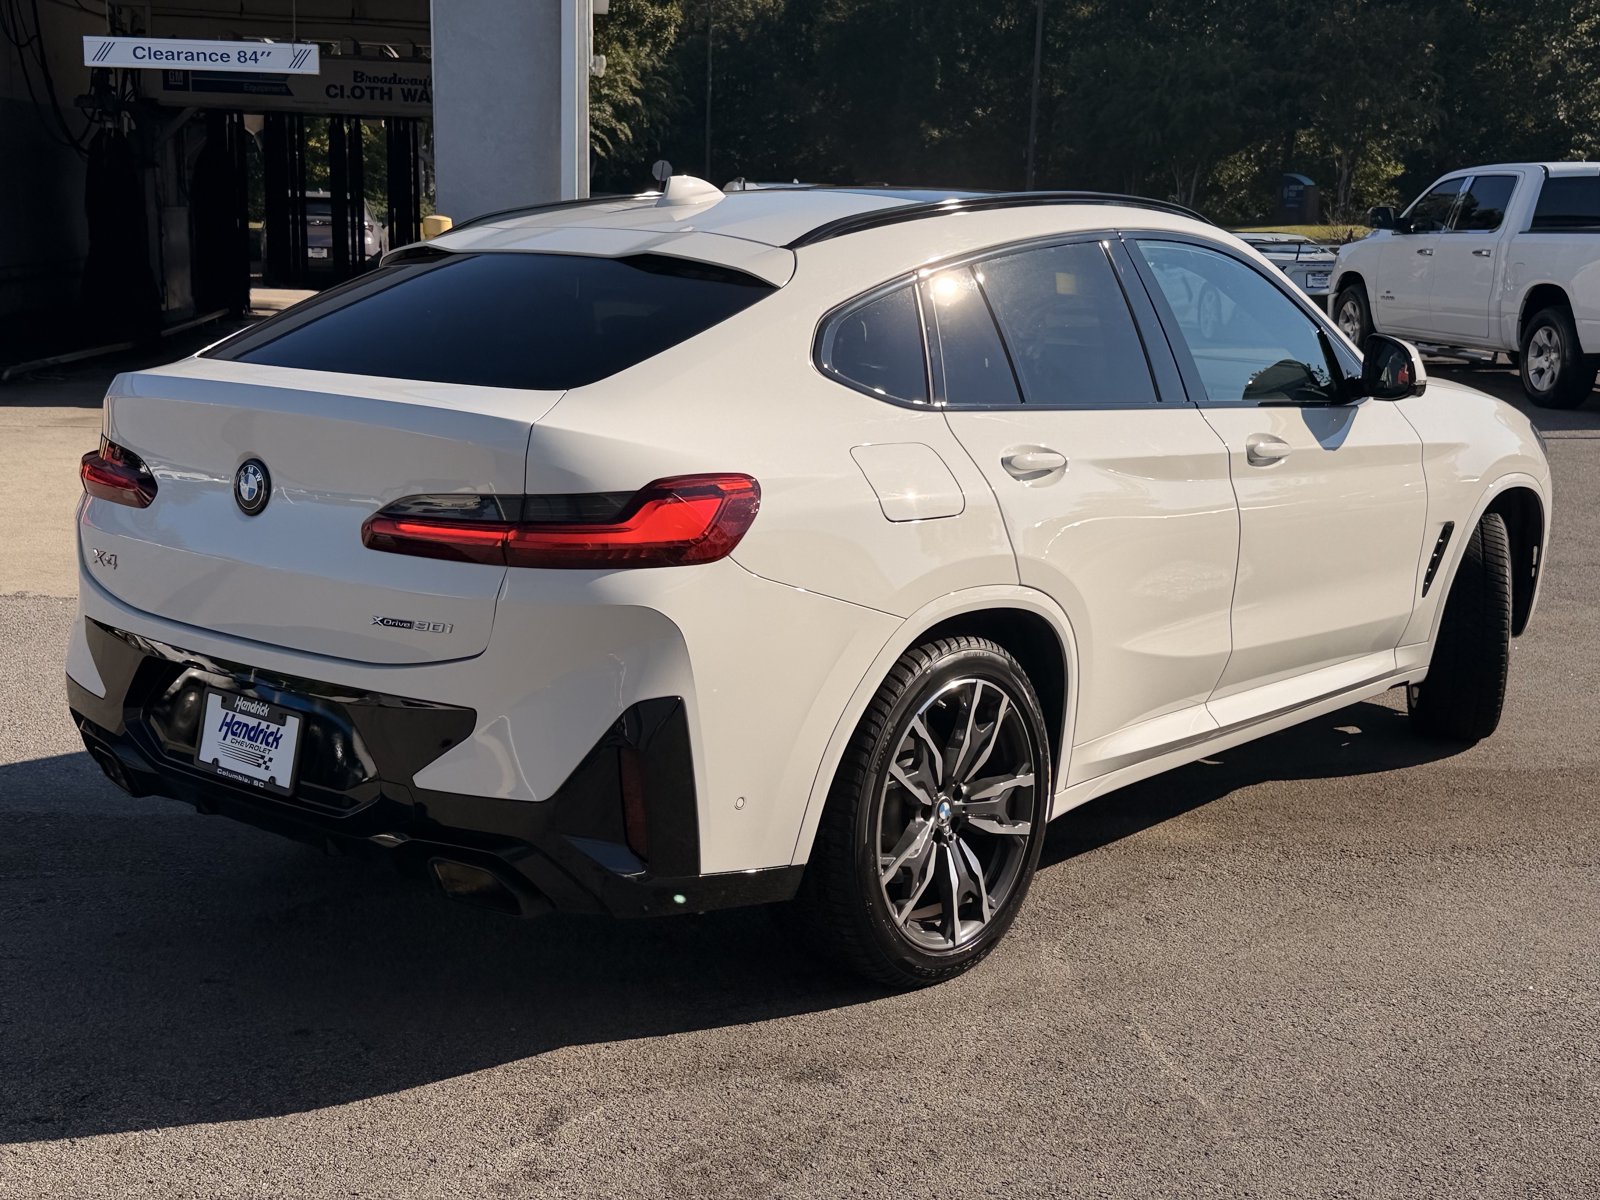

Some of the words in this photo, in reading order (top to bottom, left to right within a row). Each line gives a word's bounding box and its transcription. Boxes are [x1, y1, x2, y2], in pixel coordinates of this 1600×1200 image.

[132, 45, 231, 63] Clearance
[92, 547, 118, 570] X4
[233, 695, 270, 717] Hendrick
[218, 711, 283, 750] Hendrick
[230, 737, 272, 755] CHEVROLET
